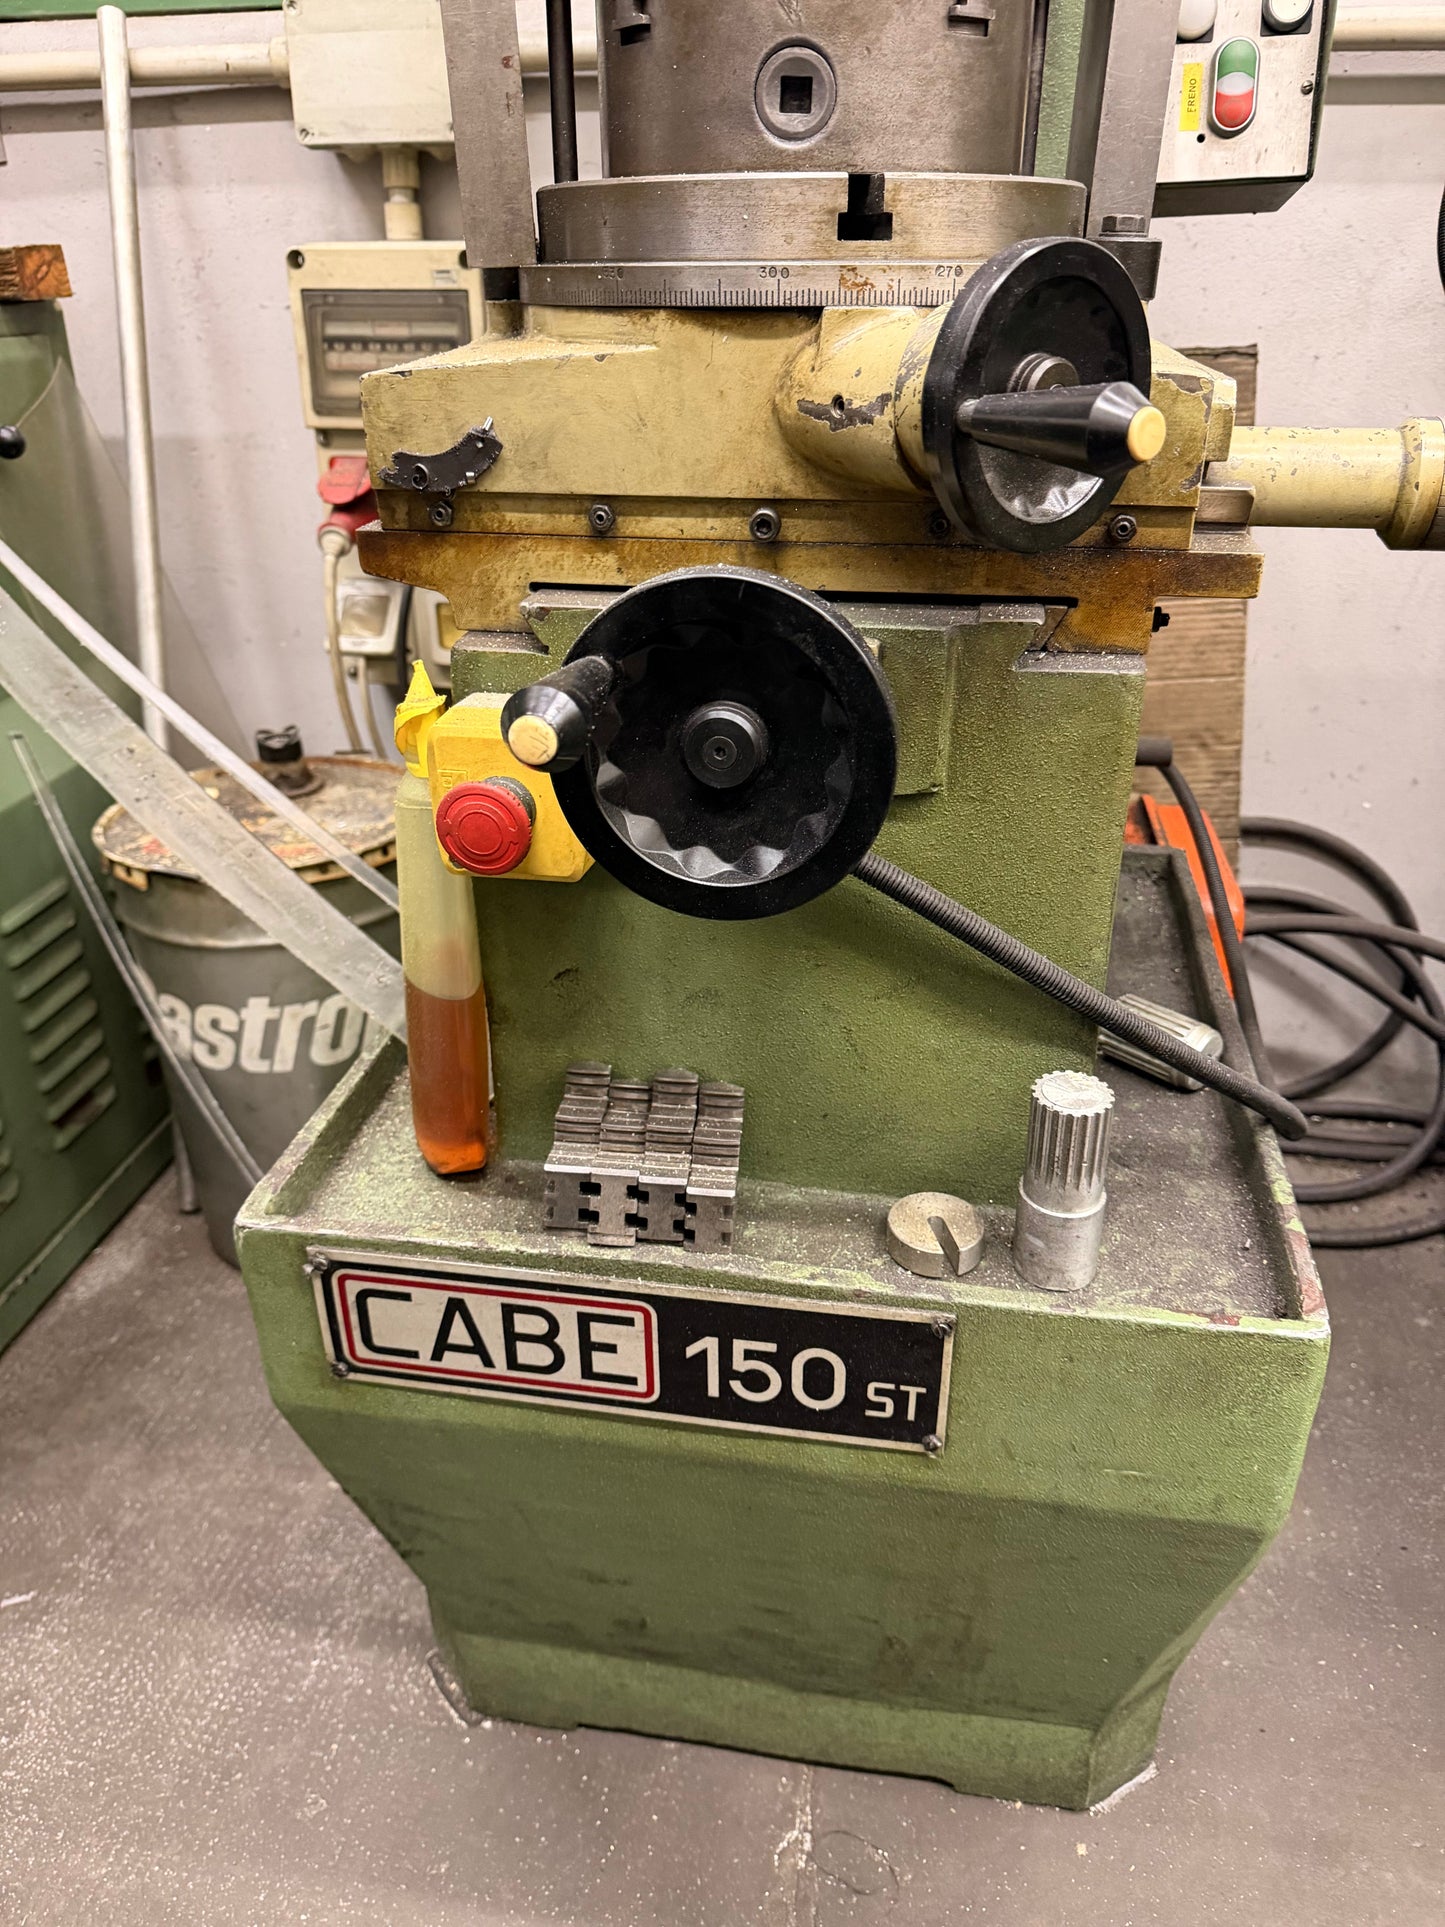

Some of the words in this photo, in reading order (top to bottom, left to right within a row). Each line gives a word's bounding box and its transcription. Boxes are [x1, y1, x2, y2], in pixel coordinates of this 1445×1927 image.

[1187, 78, 1197, 112] FRENO
[759, 266, 790, 279] 300
[935, 265, 963, 278] 270
[138, 972, 383, 1074] astro
[355, 1287, 639, 1386] CABE
[685, 1335, 847, 1410] 150
[865, 1382, 926, 1421] ST
